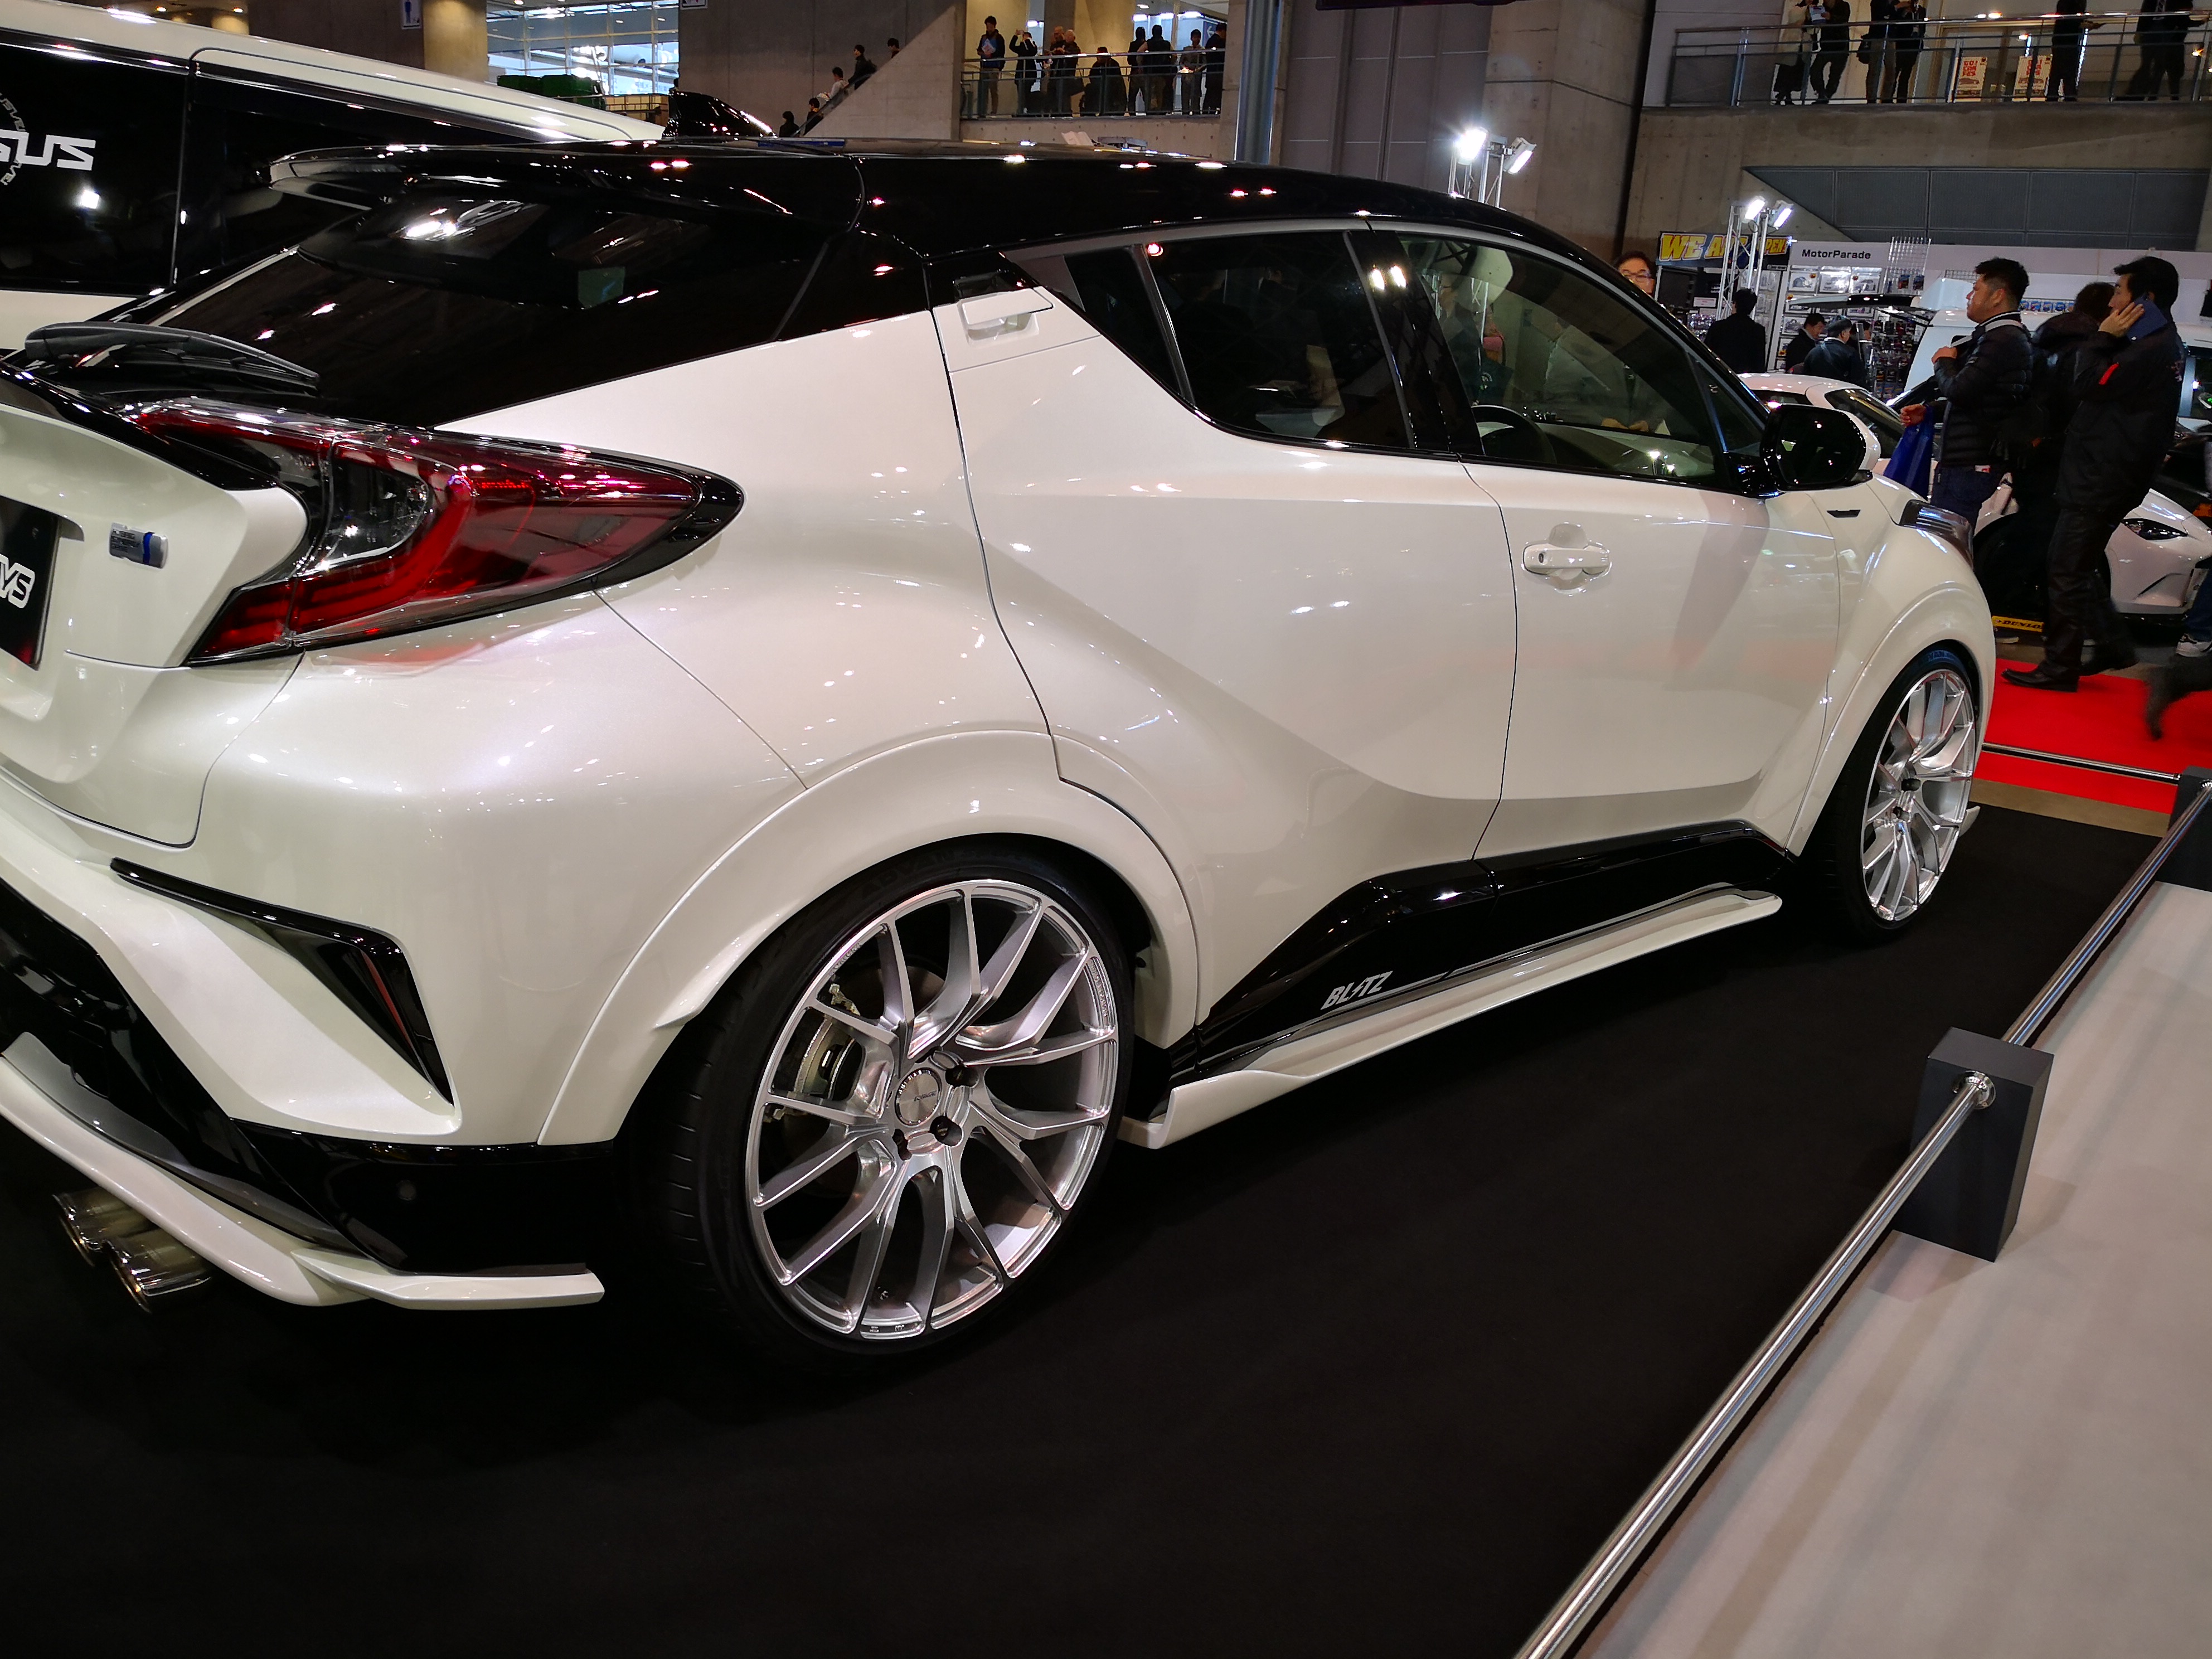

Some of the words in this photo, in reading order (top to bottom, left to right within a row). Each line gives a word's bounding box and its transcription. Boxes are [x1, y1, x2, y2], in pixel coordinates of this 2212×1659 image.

[1661, 234, 1706, 260] WE
[1802, 249, 1871, 259] MotorParade
[2002, 620, 2042, 629] DUNLO
[1320, 971, 1393, 1010] BLITZ
